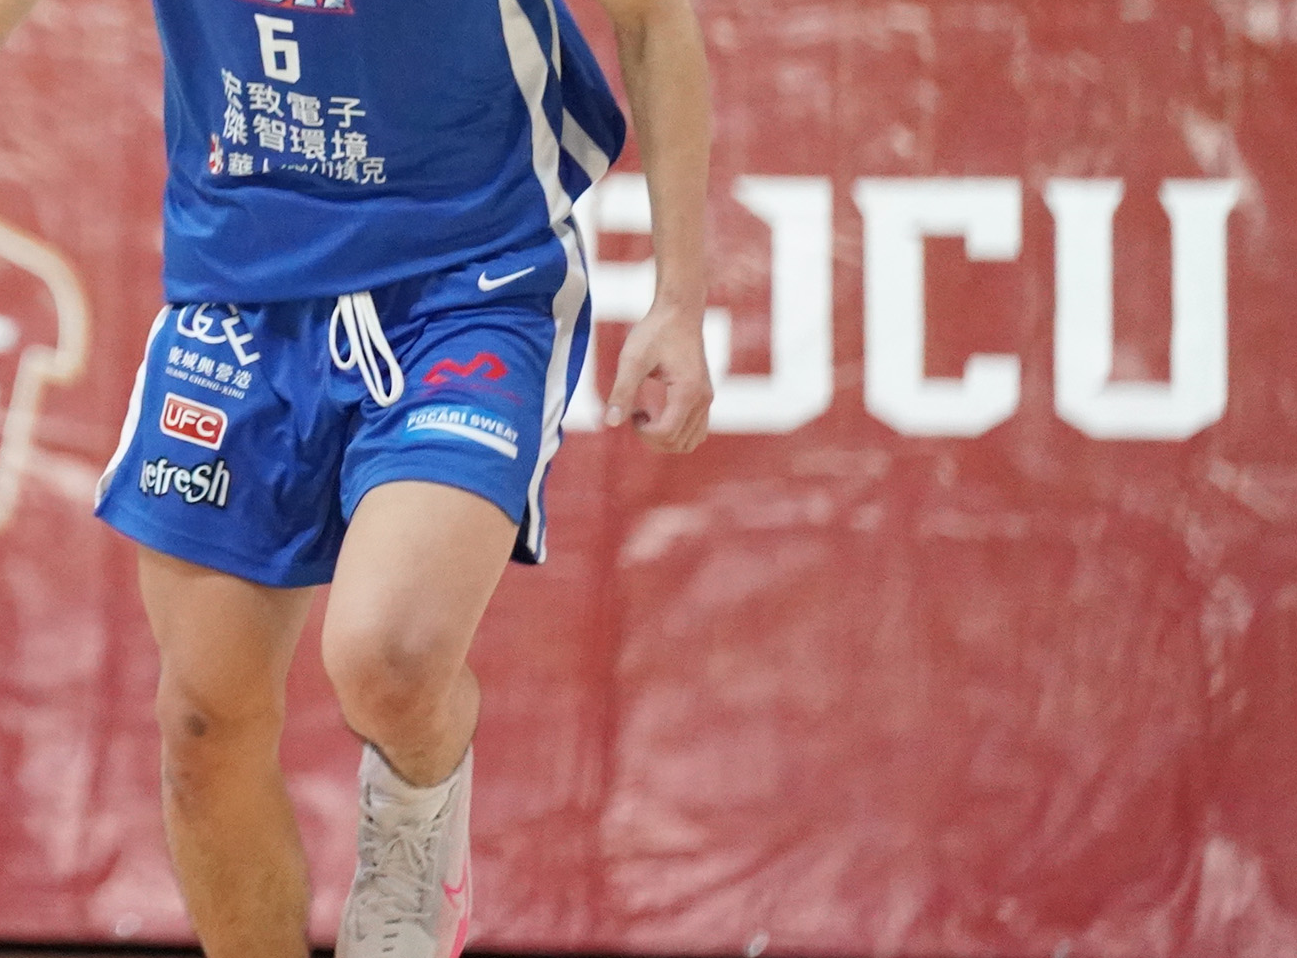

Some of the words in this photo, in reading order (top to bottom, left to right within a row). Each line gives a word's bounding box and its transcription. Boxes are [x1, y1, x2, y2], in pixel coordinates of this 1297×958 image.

[254, 13, 301, 84] 6
[223, 108, 369, 163] 傑智環境
[165, 402, 219, 439] UFC
[406, 408, 467, 429] POCARI
[469, 413, 519, 443] SWEAT
